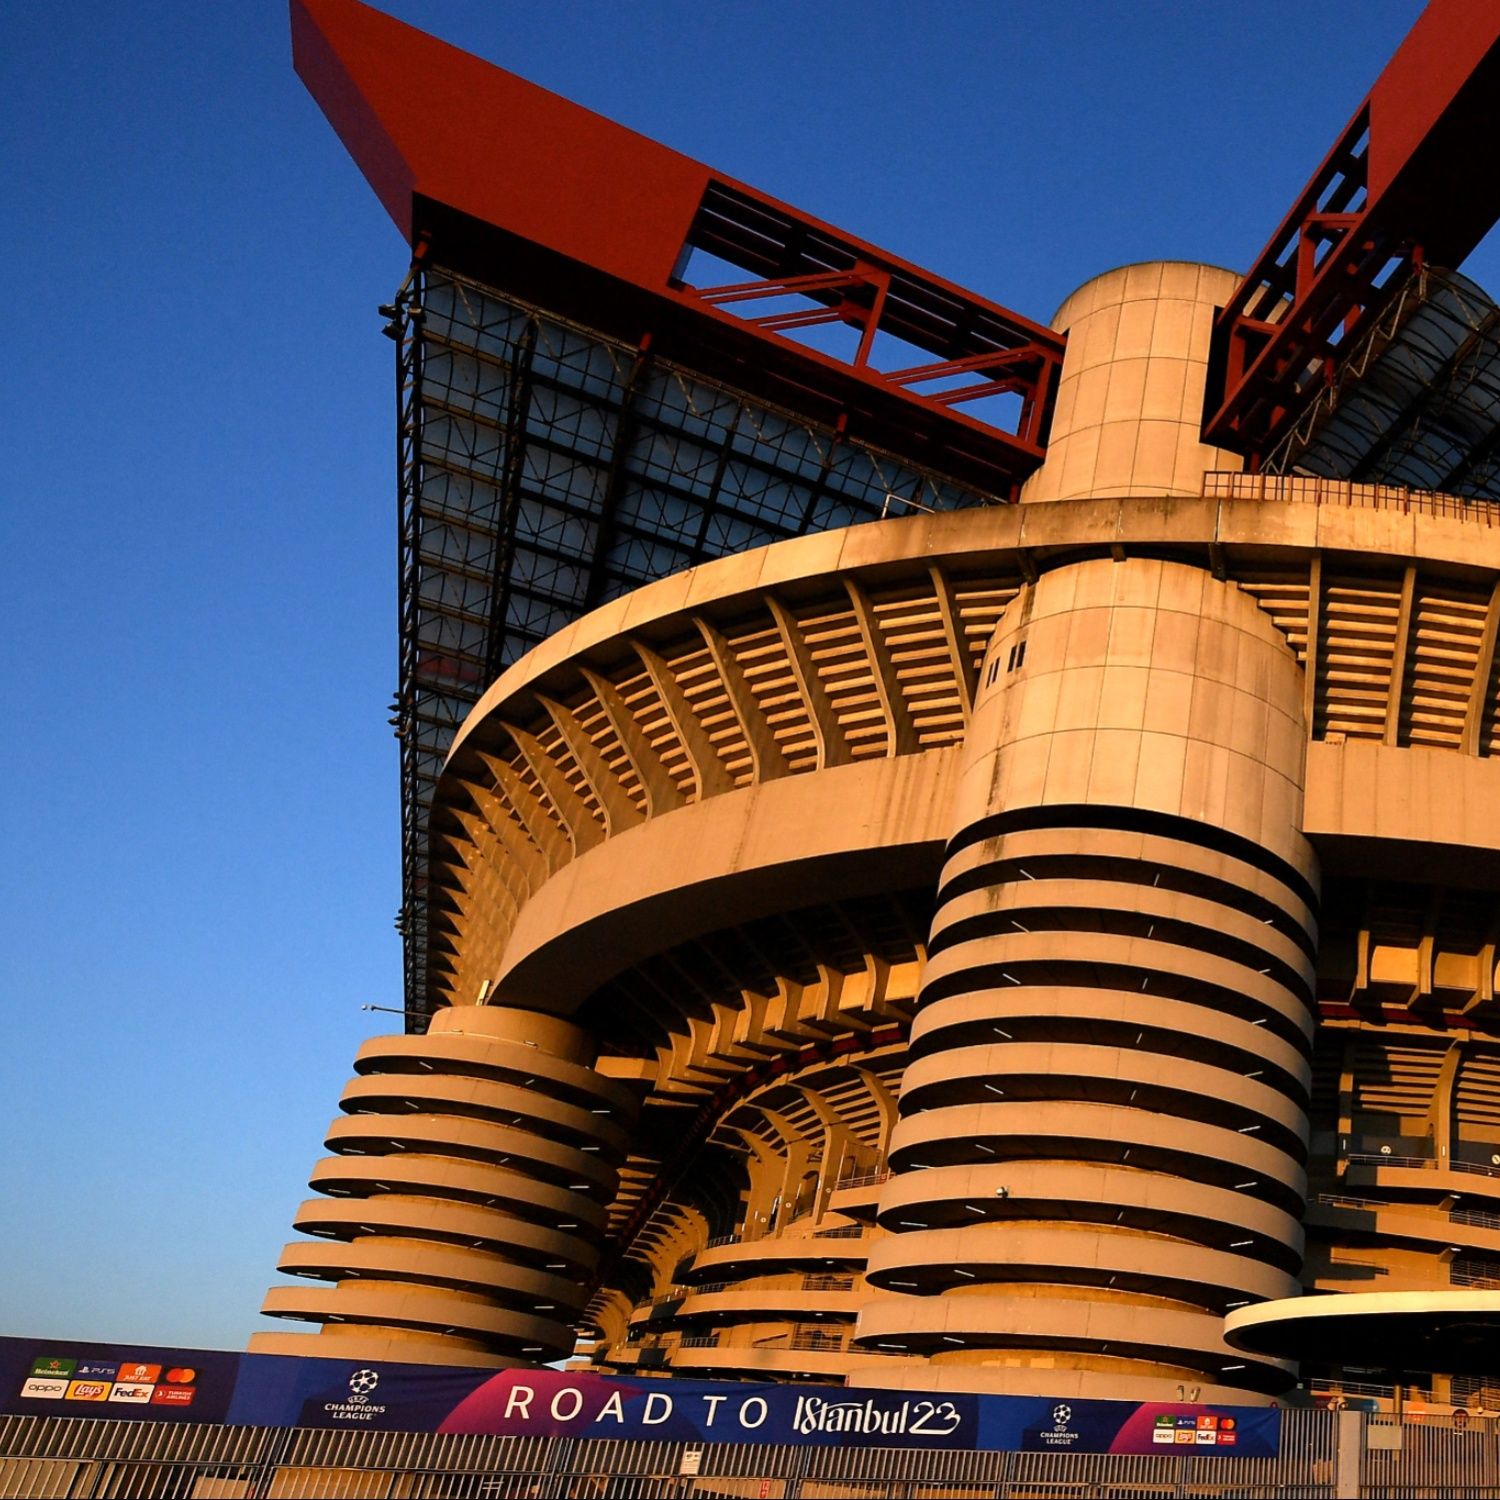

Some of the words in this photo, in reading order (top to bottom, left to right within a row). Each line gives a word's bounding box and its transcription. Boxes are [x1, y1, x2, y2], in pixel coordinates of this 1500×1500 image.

[91, 1367, 116, 1375] PS5
[28, 1384, 62, 1392] oppo
[114, 1387, 149, 1398] FedEx
[324, 1403, 386, 1413] CHAMPIONS
[504, 1385, 673, 1424] ROAD
[702, 1395, 768, 1428] TO
[332, 1411, 373, 1420] LEAGUE
